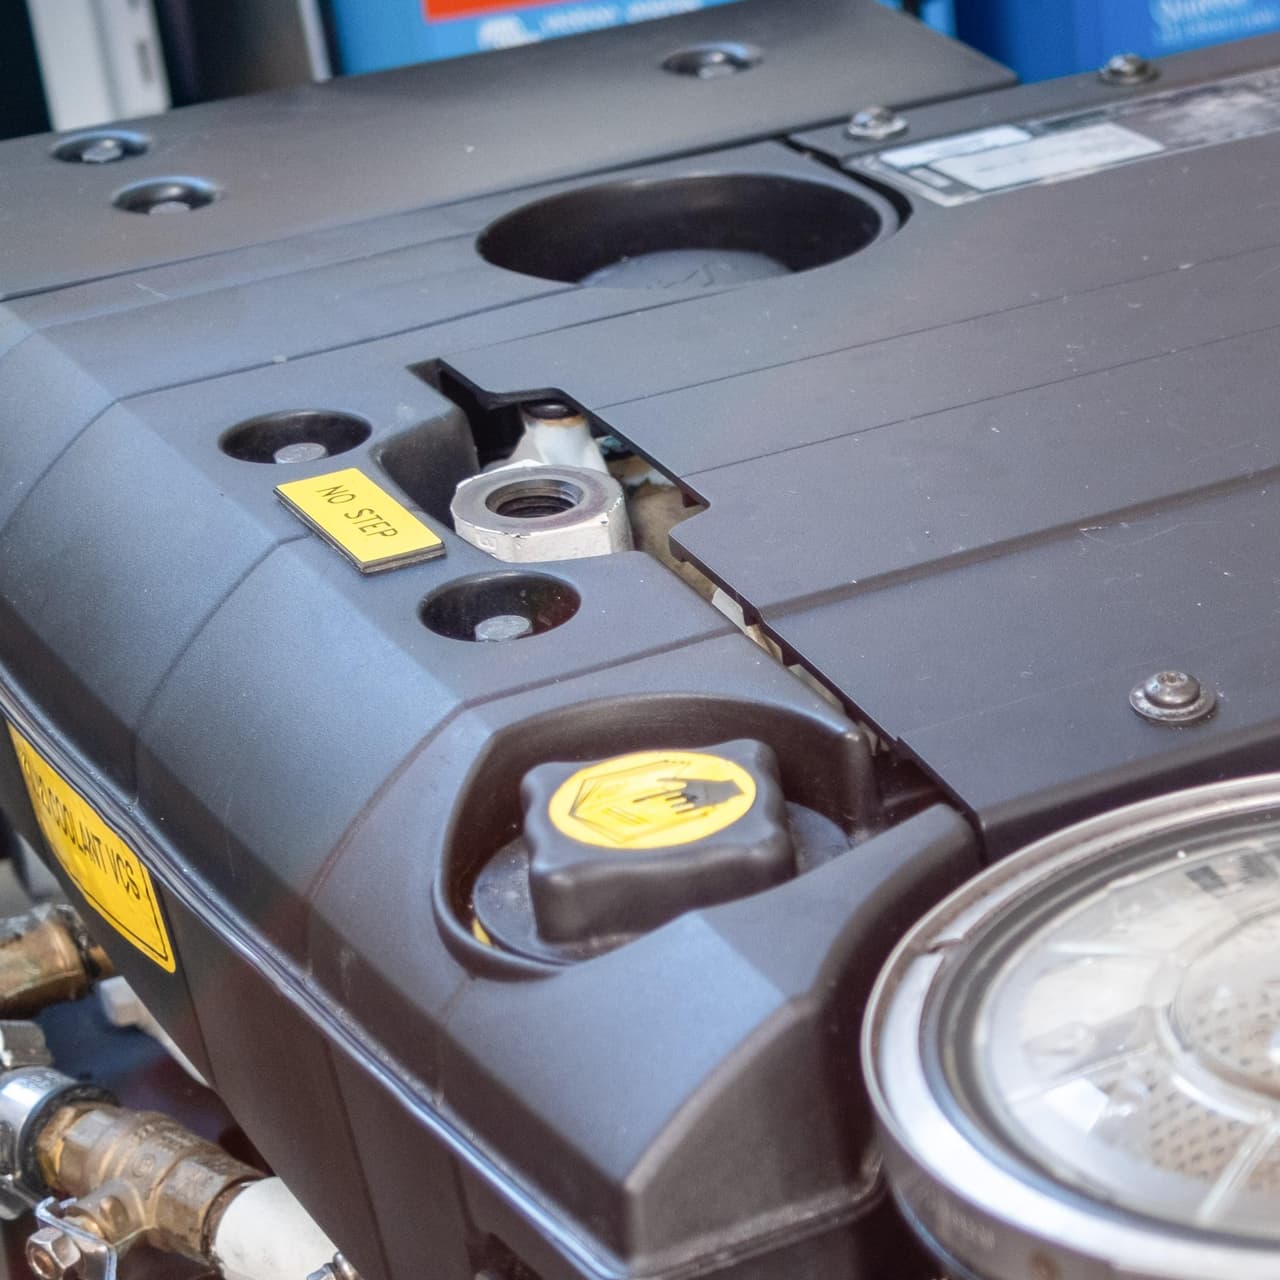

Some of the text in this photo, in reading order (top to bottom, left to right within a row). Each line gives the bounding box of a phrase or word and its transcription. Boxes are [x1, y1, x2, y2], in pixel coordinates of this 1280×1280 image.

[316, 484, 398, 538] NO STEP
[104, 843, 141, 901] VCS
